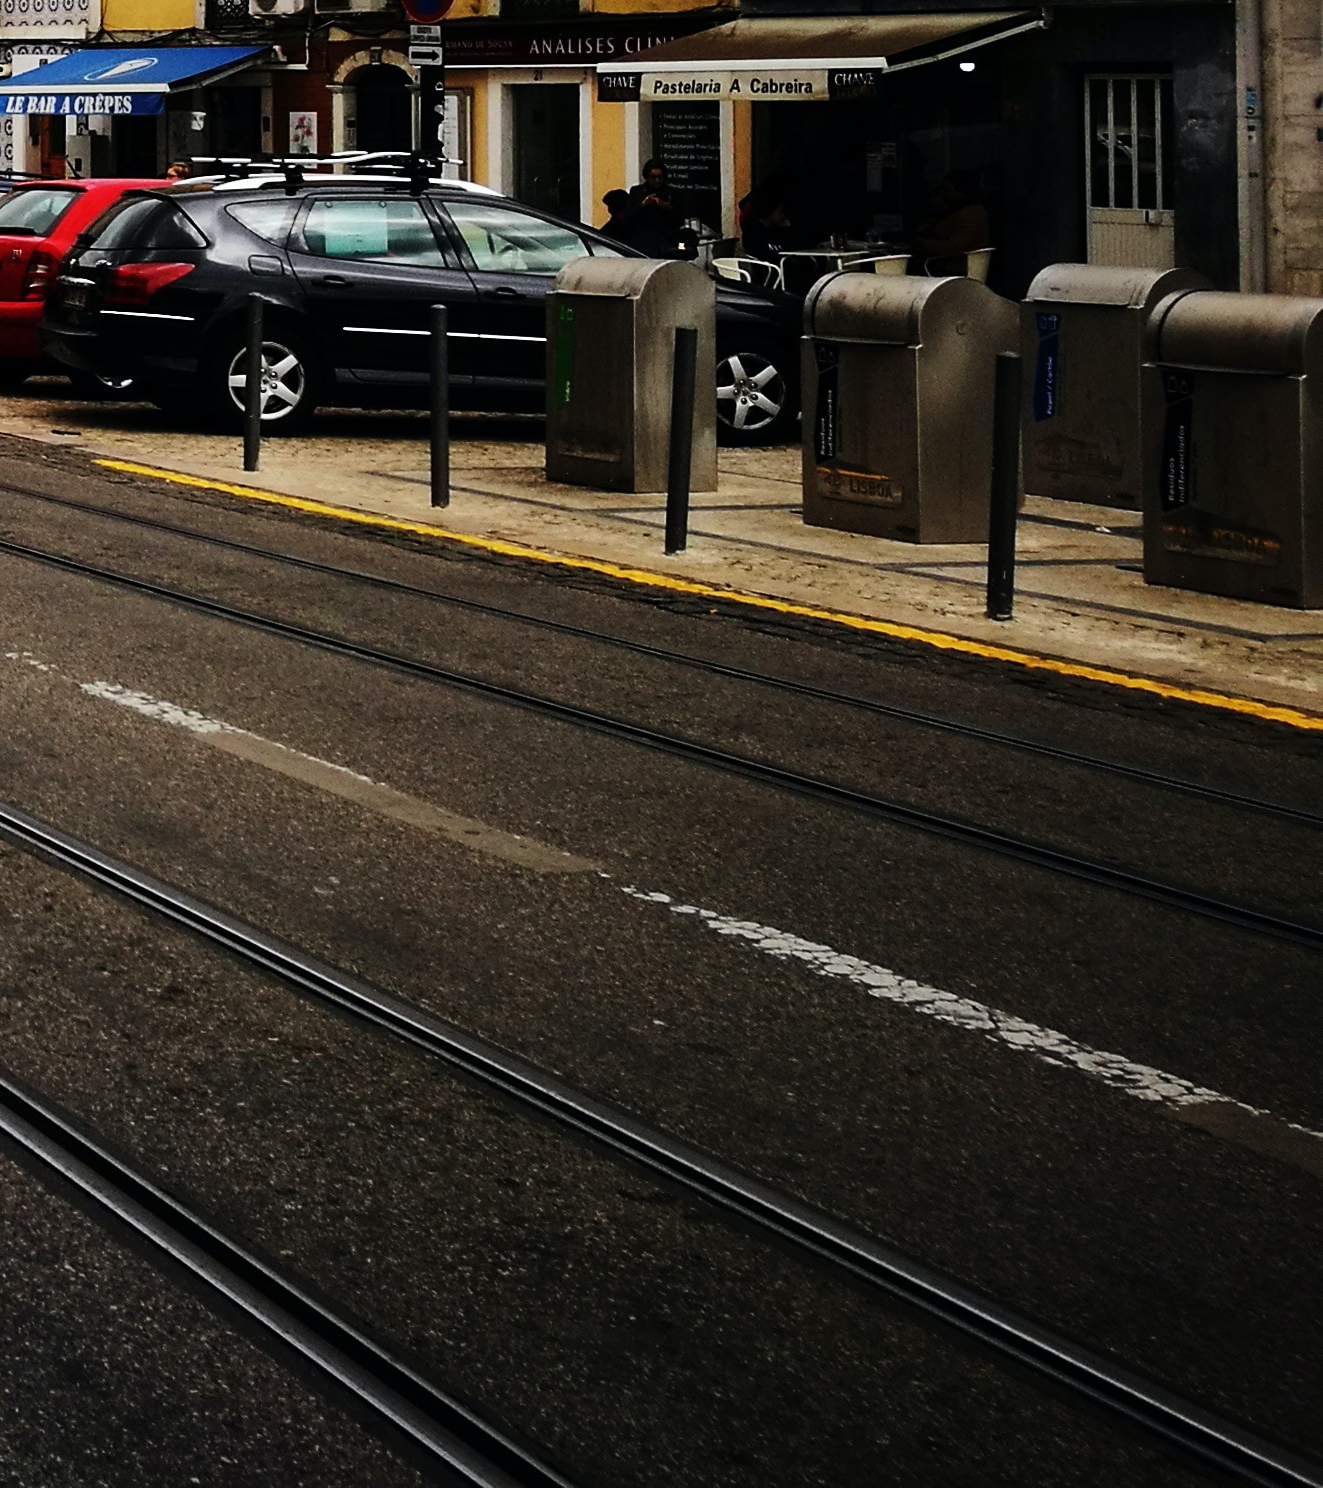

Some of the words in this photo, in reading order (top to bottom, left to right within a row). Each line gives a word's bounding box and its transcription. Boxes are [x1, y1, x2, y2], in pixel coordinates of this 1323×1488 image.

[602, 76, 636, 89] CHAVE
[653, 79, 721, 95] Pastelaria
[729, 79, 741, 93] A
[750, 78, 813, 94] Cabreira
[834, 72, 876, 86] CHAVE
[6, 96, 25, 113] LE
[27, 95, 57, 113] BAR
[60, 96, 71, 113] A
[73, 93, 133, 114] CRÊPES
